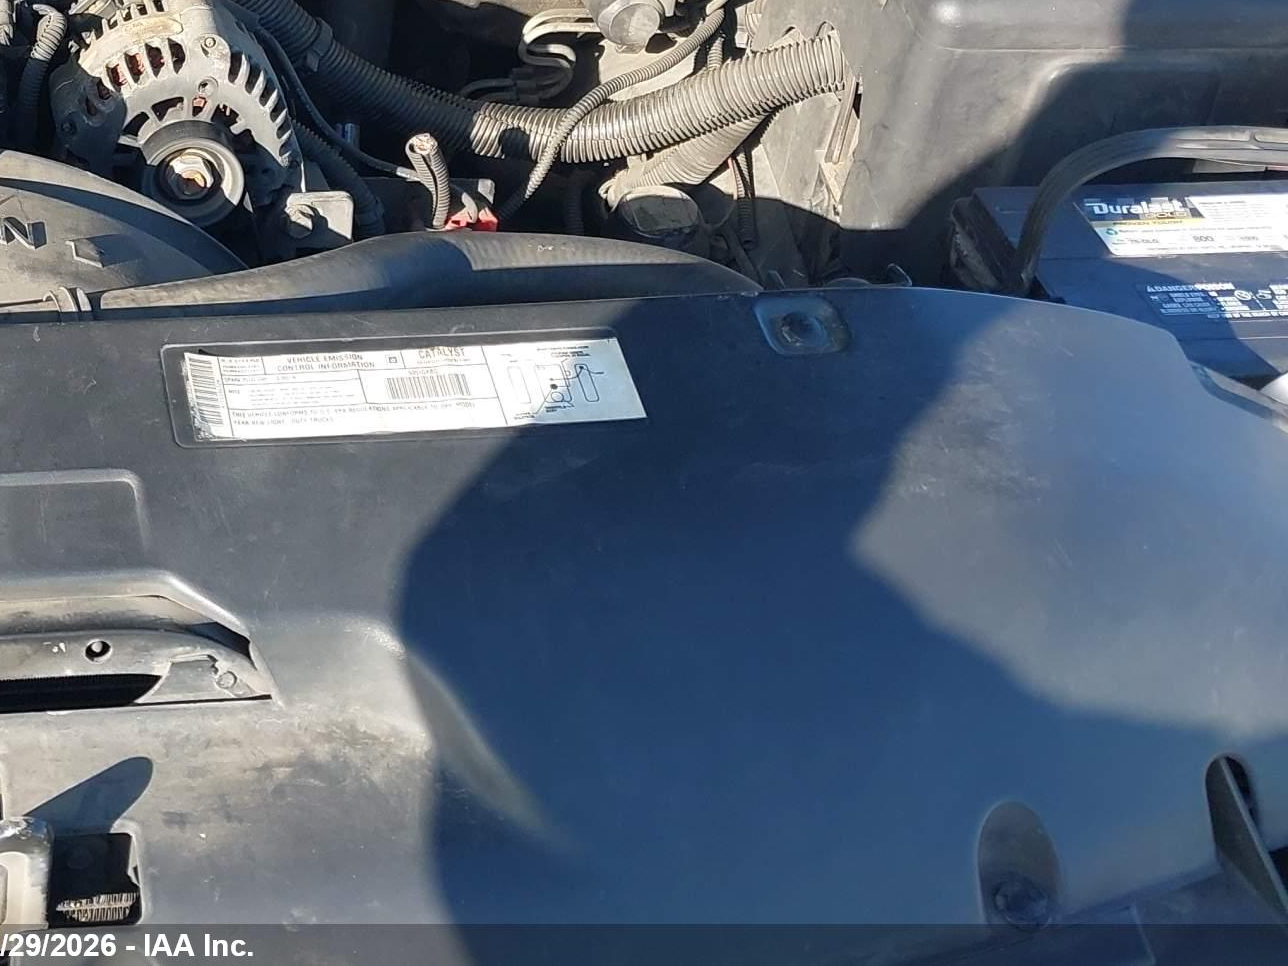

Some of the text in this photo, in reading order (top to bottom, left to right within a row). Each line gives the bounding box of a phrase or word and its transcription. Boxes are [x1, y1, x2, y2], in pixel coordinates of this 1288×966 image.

[1084, 198, 1184, 215] Duralast
[286, 353, 364, 364] VEHICLE EMISSION
[418, 346, 466, 359] CATALYST
[276, 361, 375, 372] CONTROL INFORMATION
